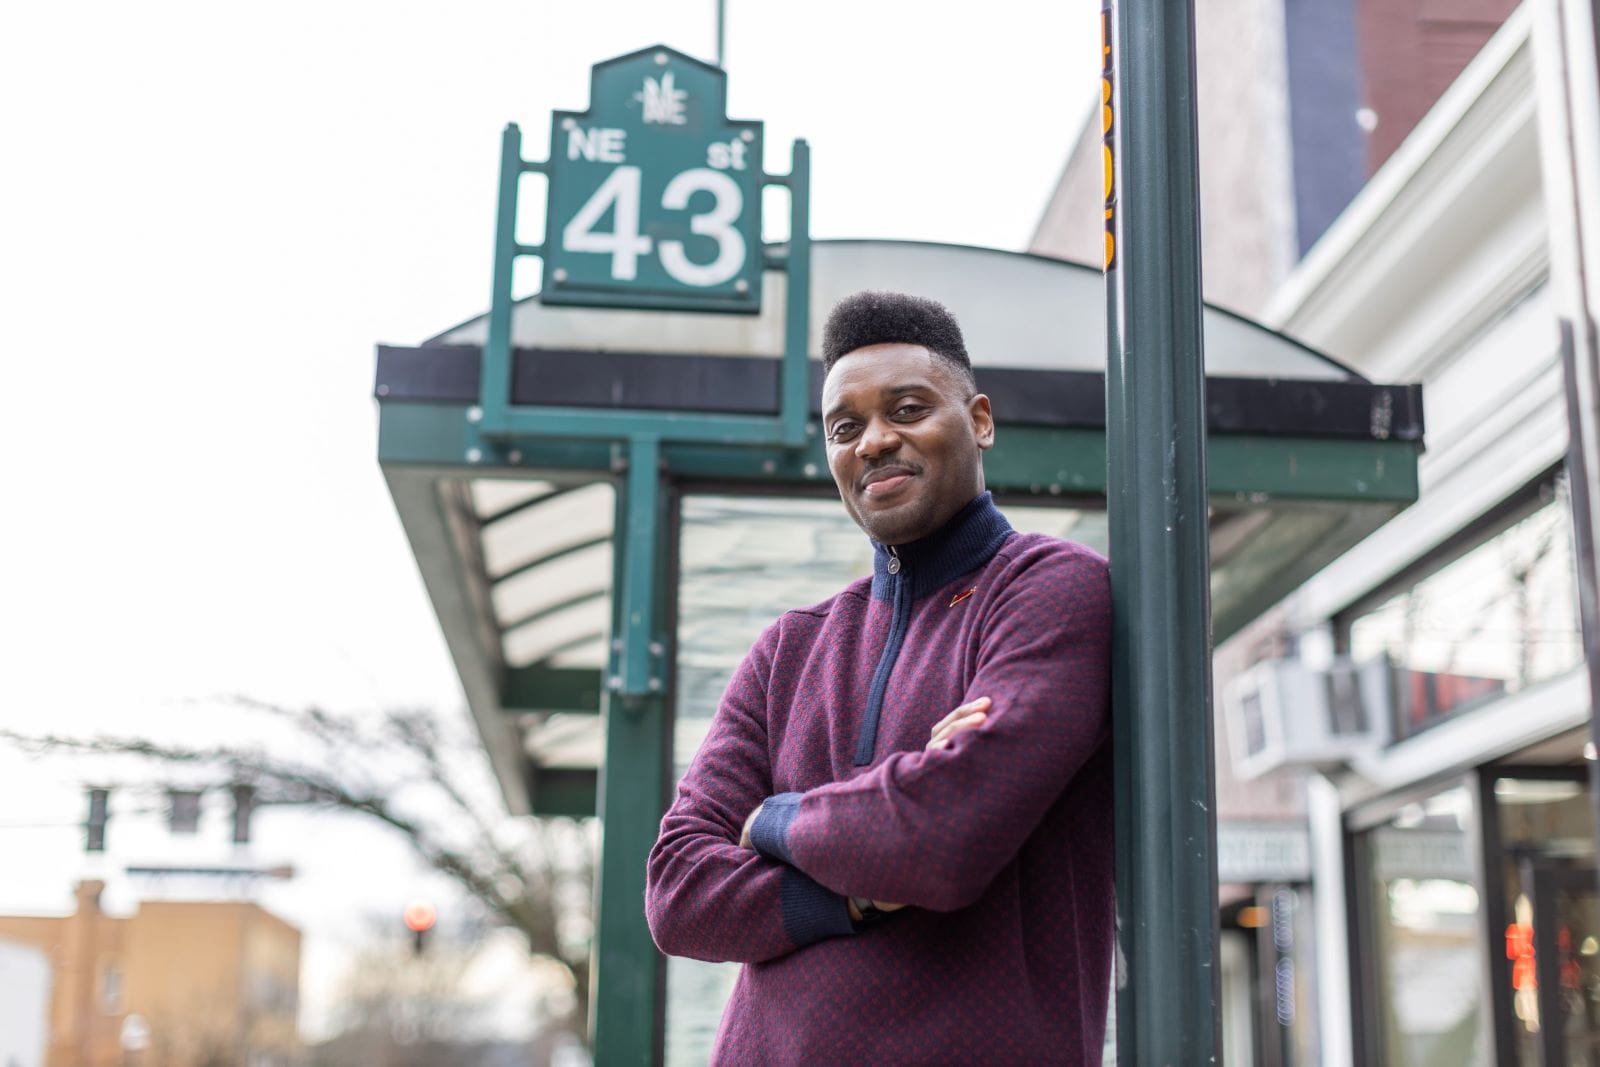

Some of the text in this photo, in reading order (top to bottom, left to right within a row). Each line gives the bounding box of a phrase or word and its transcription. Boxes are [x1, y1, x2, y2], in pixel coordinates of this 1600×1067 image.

[567, 127, 747, 170] NE st
[562, 165, 746, 287] 43
